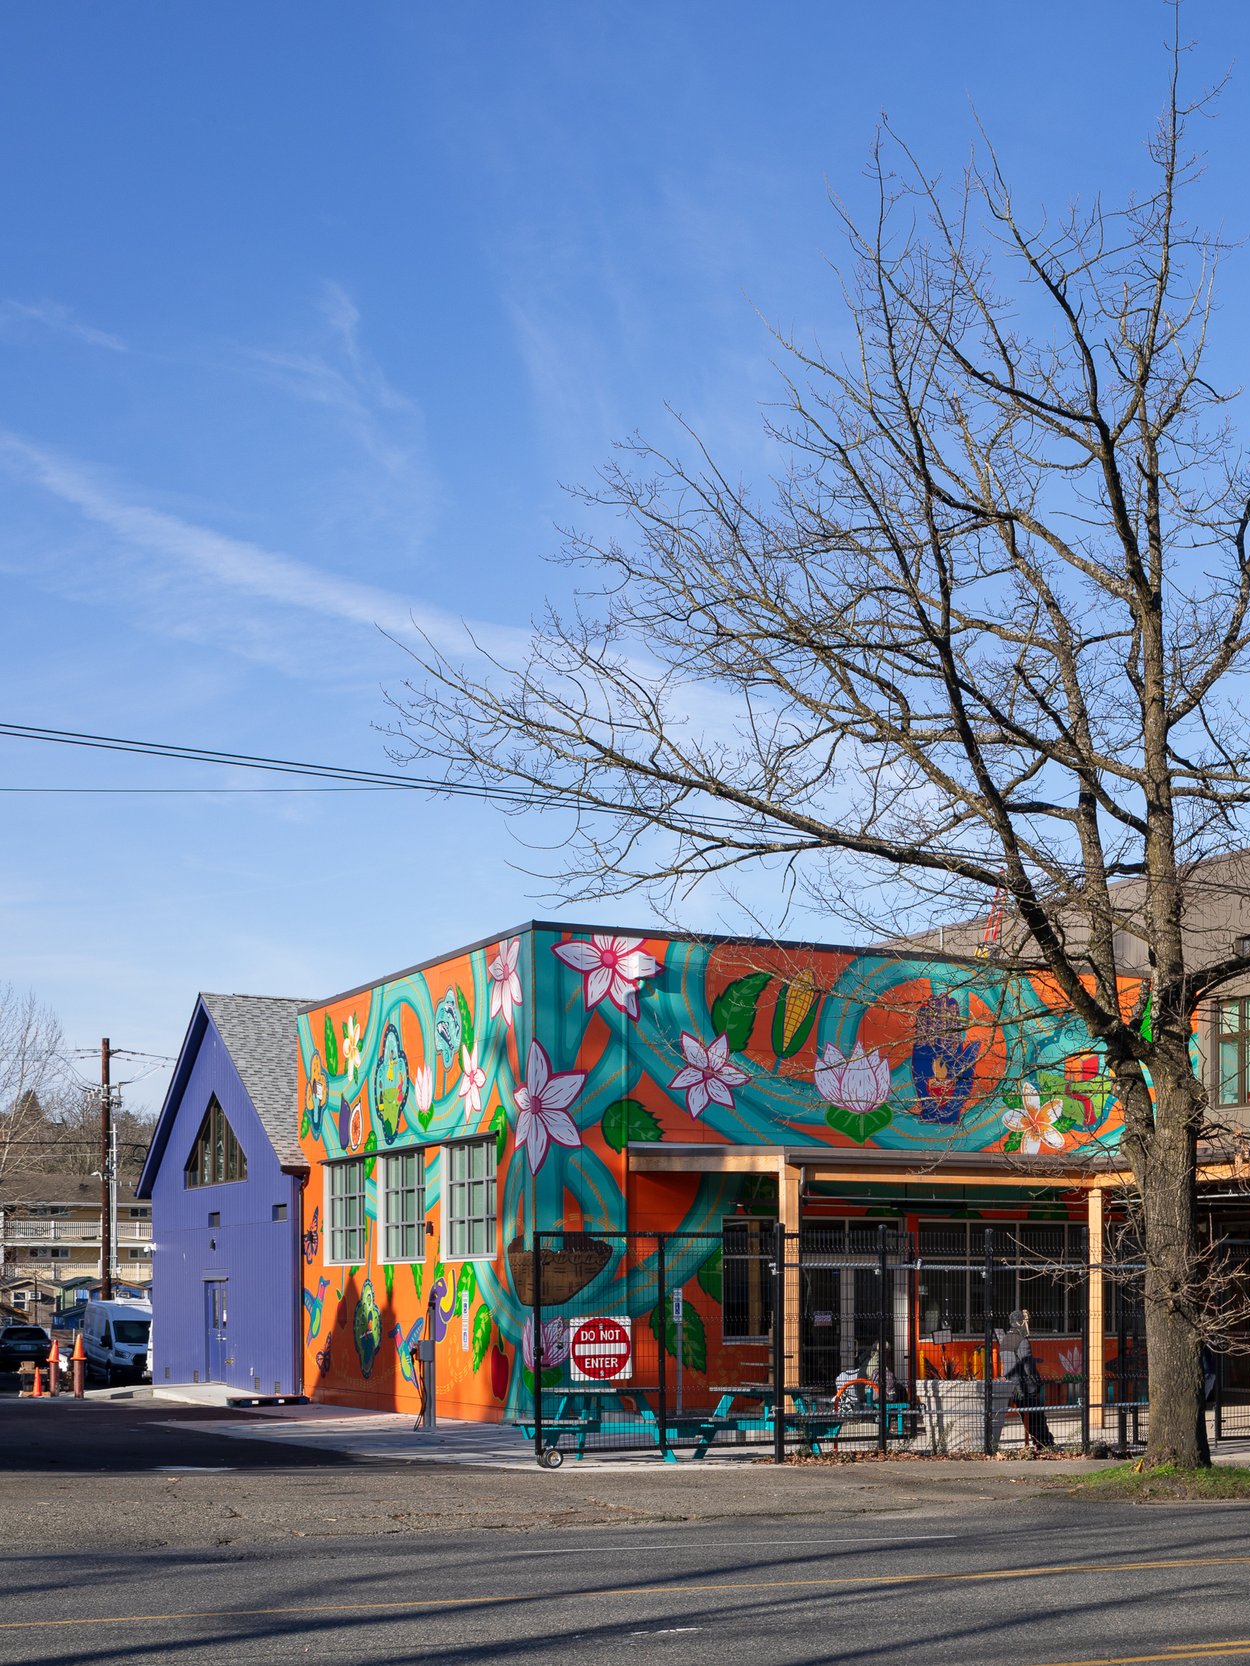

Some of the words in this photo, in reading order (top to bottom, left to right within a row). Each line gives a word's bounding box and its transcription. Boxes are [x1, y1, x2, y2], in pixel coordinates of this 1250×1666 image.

[581, 1330, 596, 1341] DO
[600, 1330, 621, 1341] NOT
[584, 1357, 619, 1369] ENTER
